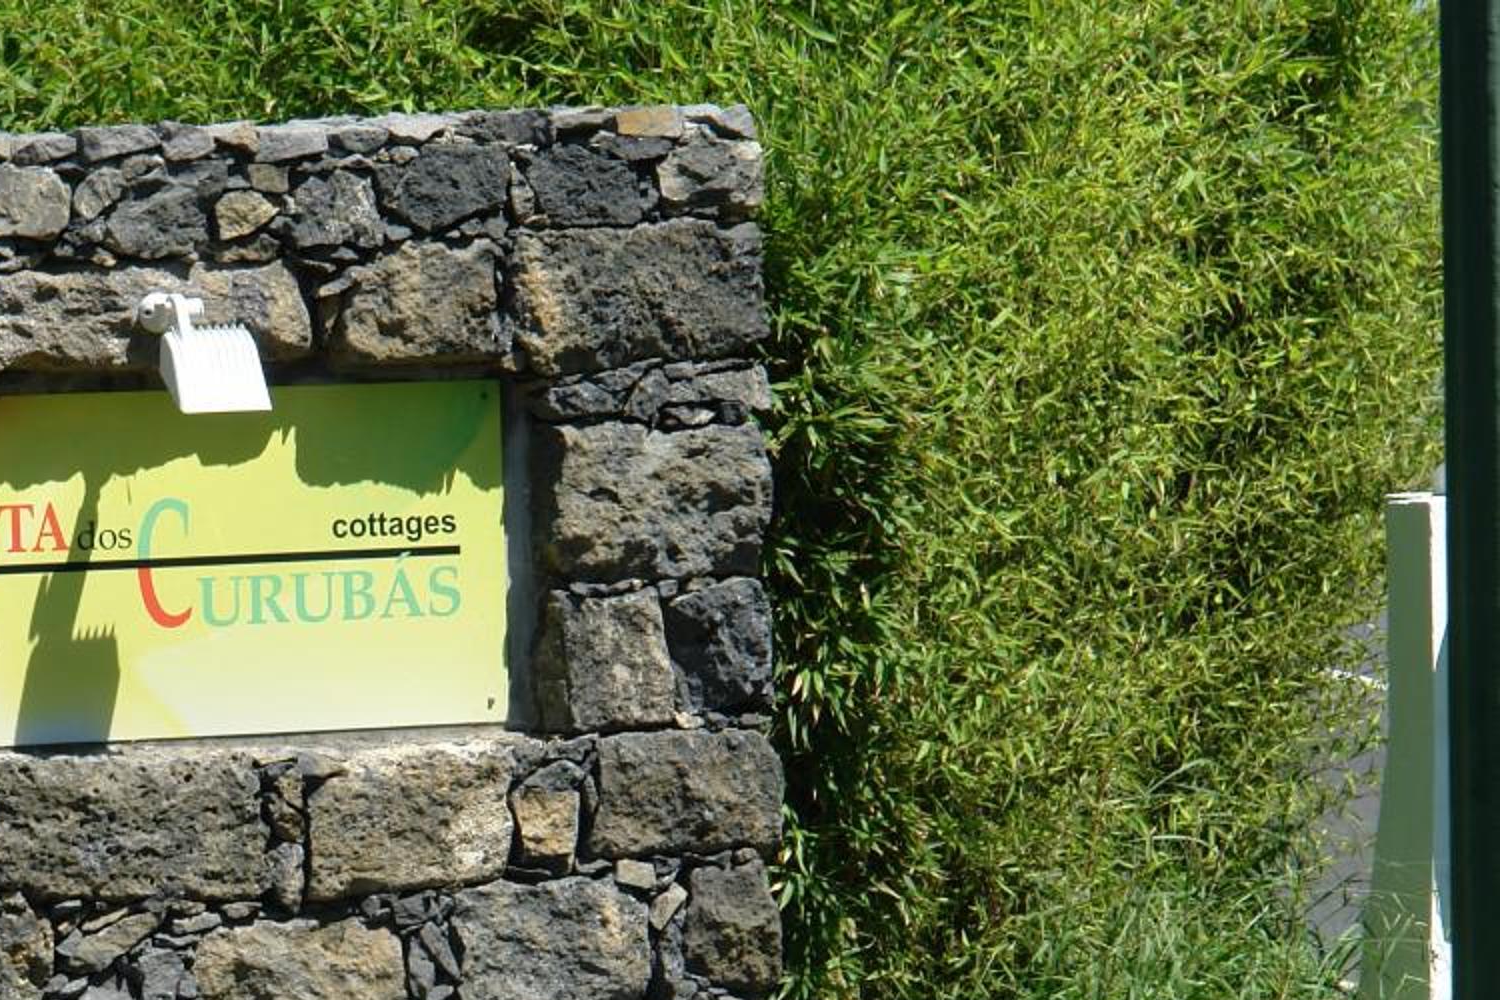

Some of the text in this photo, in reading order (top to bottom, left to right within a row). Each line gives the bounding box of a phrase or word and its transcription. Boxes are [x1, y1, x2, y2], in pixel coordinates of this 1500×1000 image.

[77, 520, 133, 551] dos
[137, 497, 461, 629] CURUBÁS
[332, 511, 457, 541] cottages
